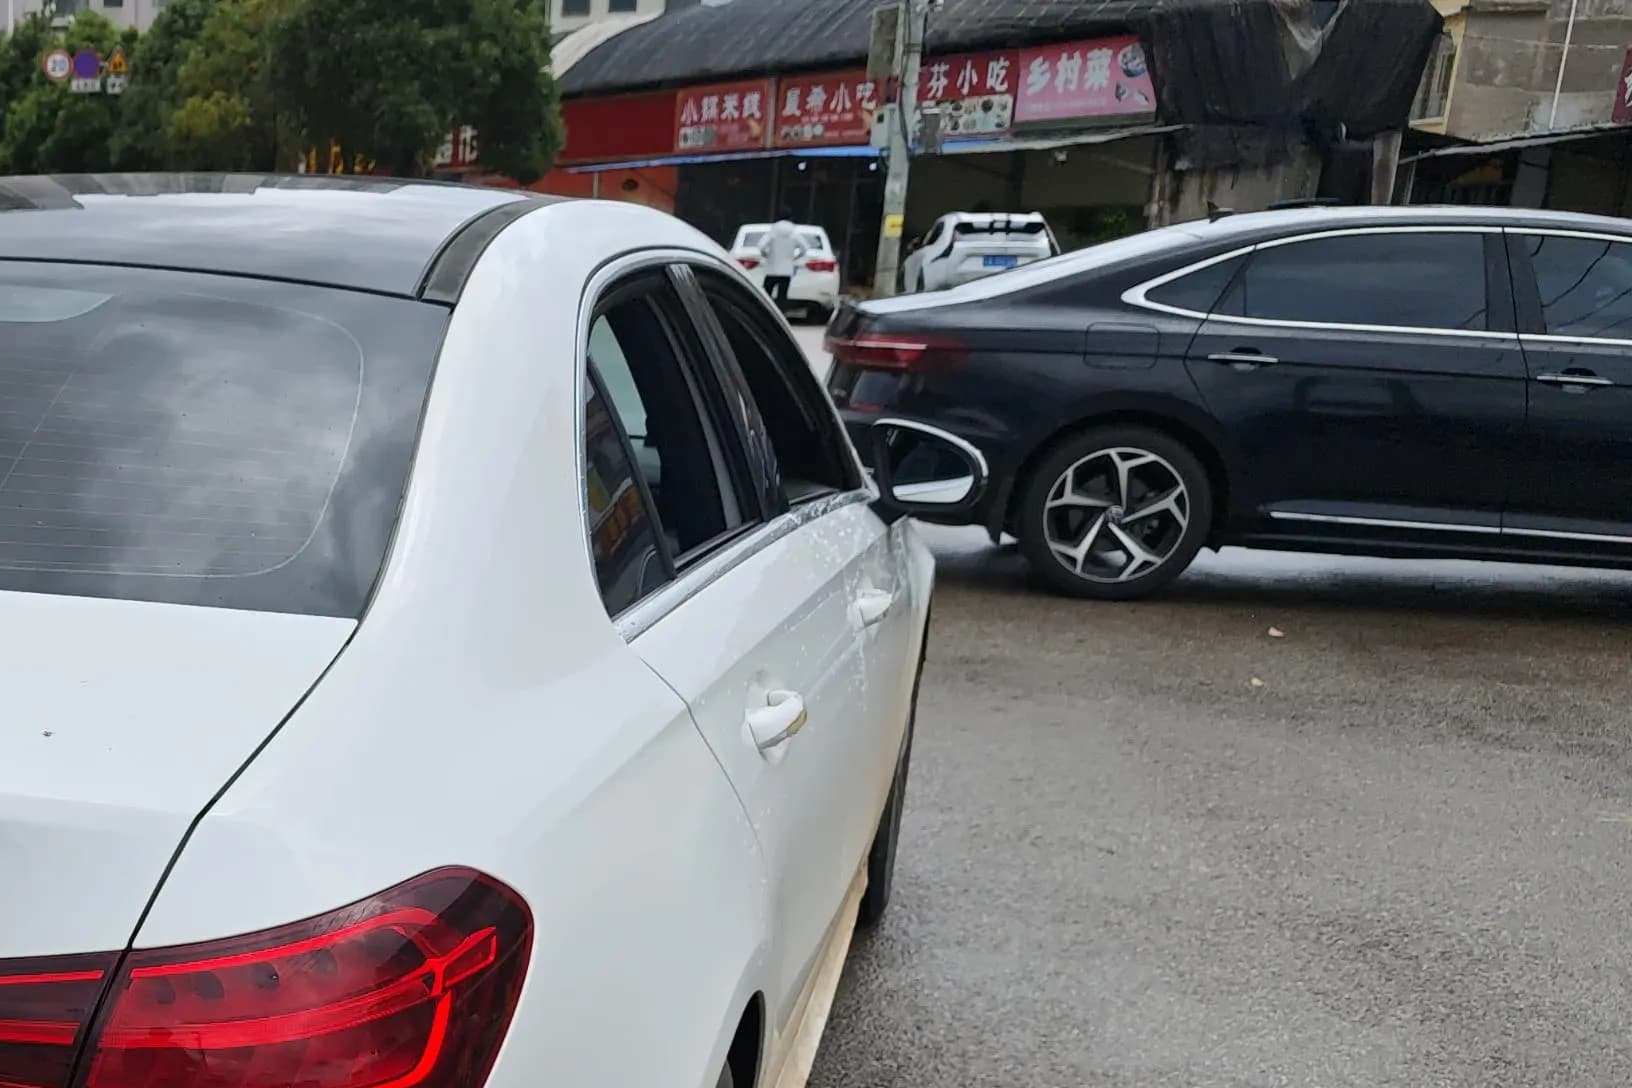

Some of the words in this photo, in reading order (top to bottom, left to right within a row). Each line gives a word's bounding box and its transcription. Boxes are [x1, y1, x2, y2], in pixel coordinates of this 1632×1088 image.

[917, 56, 1010, 99] 芬小吃
[1027, 48, 1113, 96] 乡村菜
